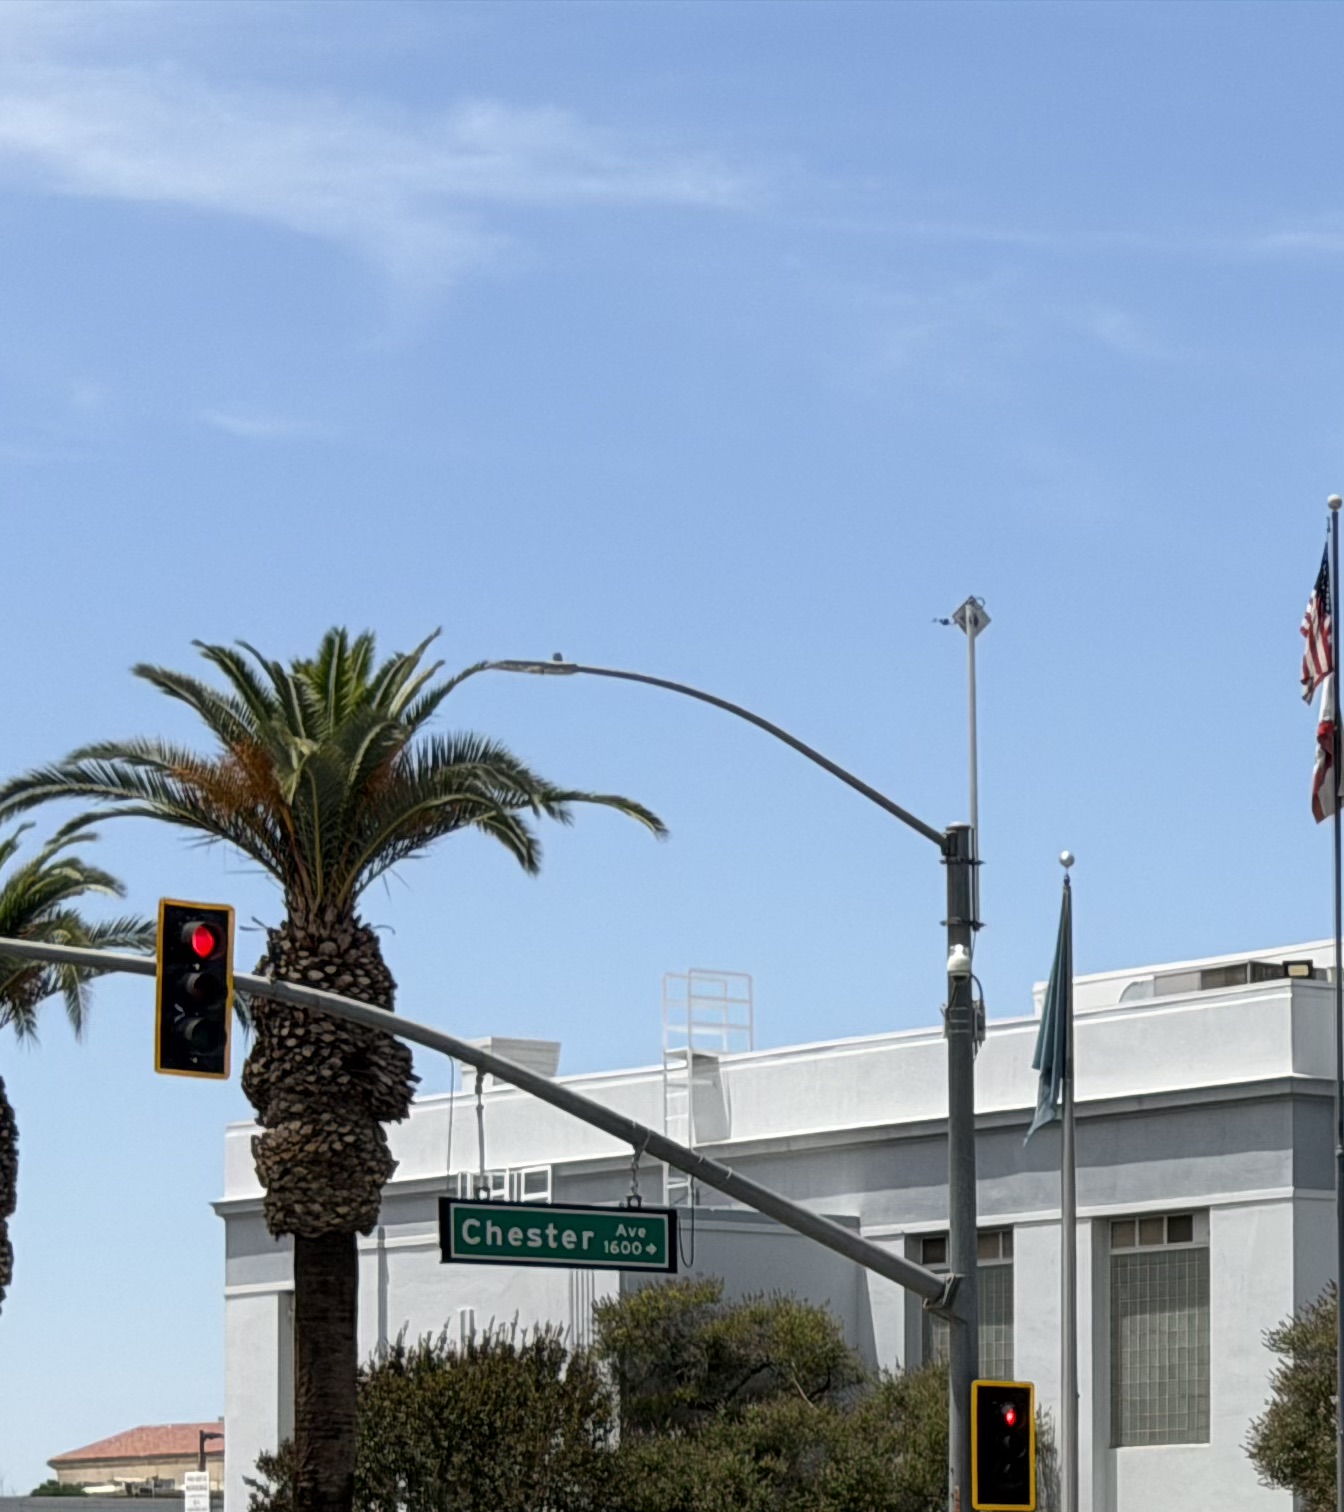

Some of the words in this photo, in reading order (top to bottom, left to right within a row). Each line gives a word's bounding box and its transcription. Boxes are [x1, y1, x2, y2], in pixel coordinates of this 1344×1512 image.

[461, 1217, 595, 1250] Chester
[615, 1223, 647, 1239] Ave
[603, 1240, 643, 1255] 1600
